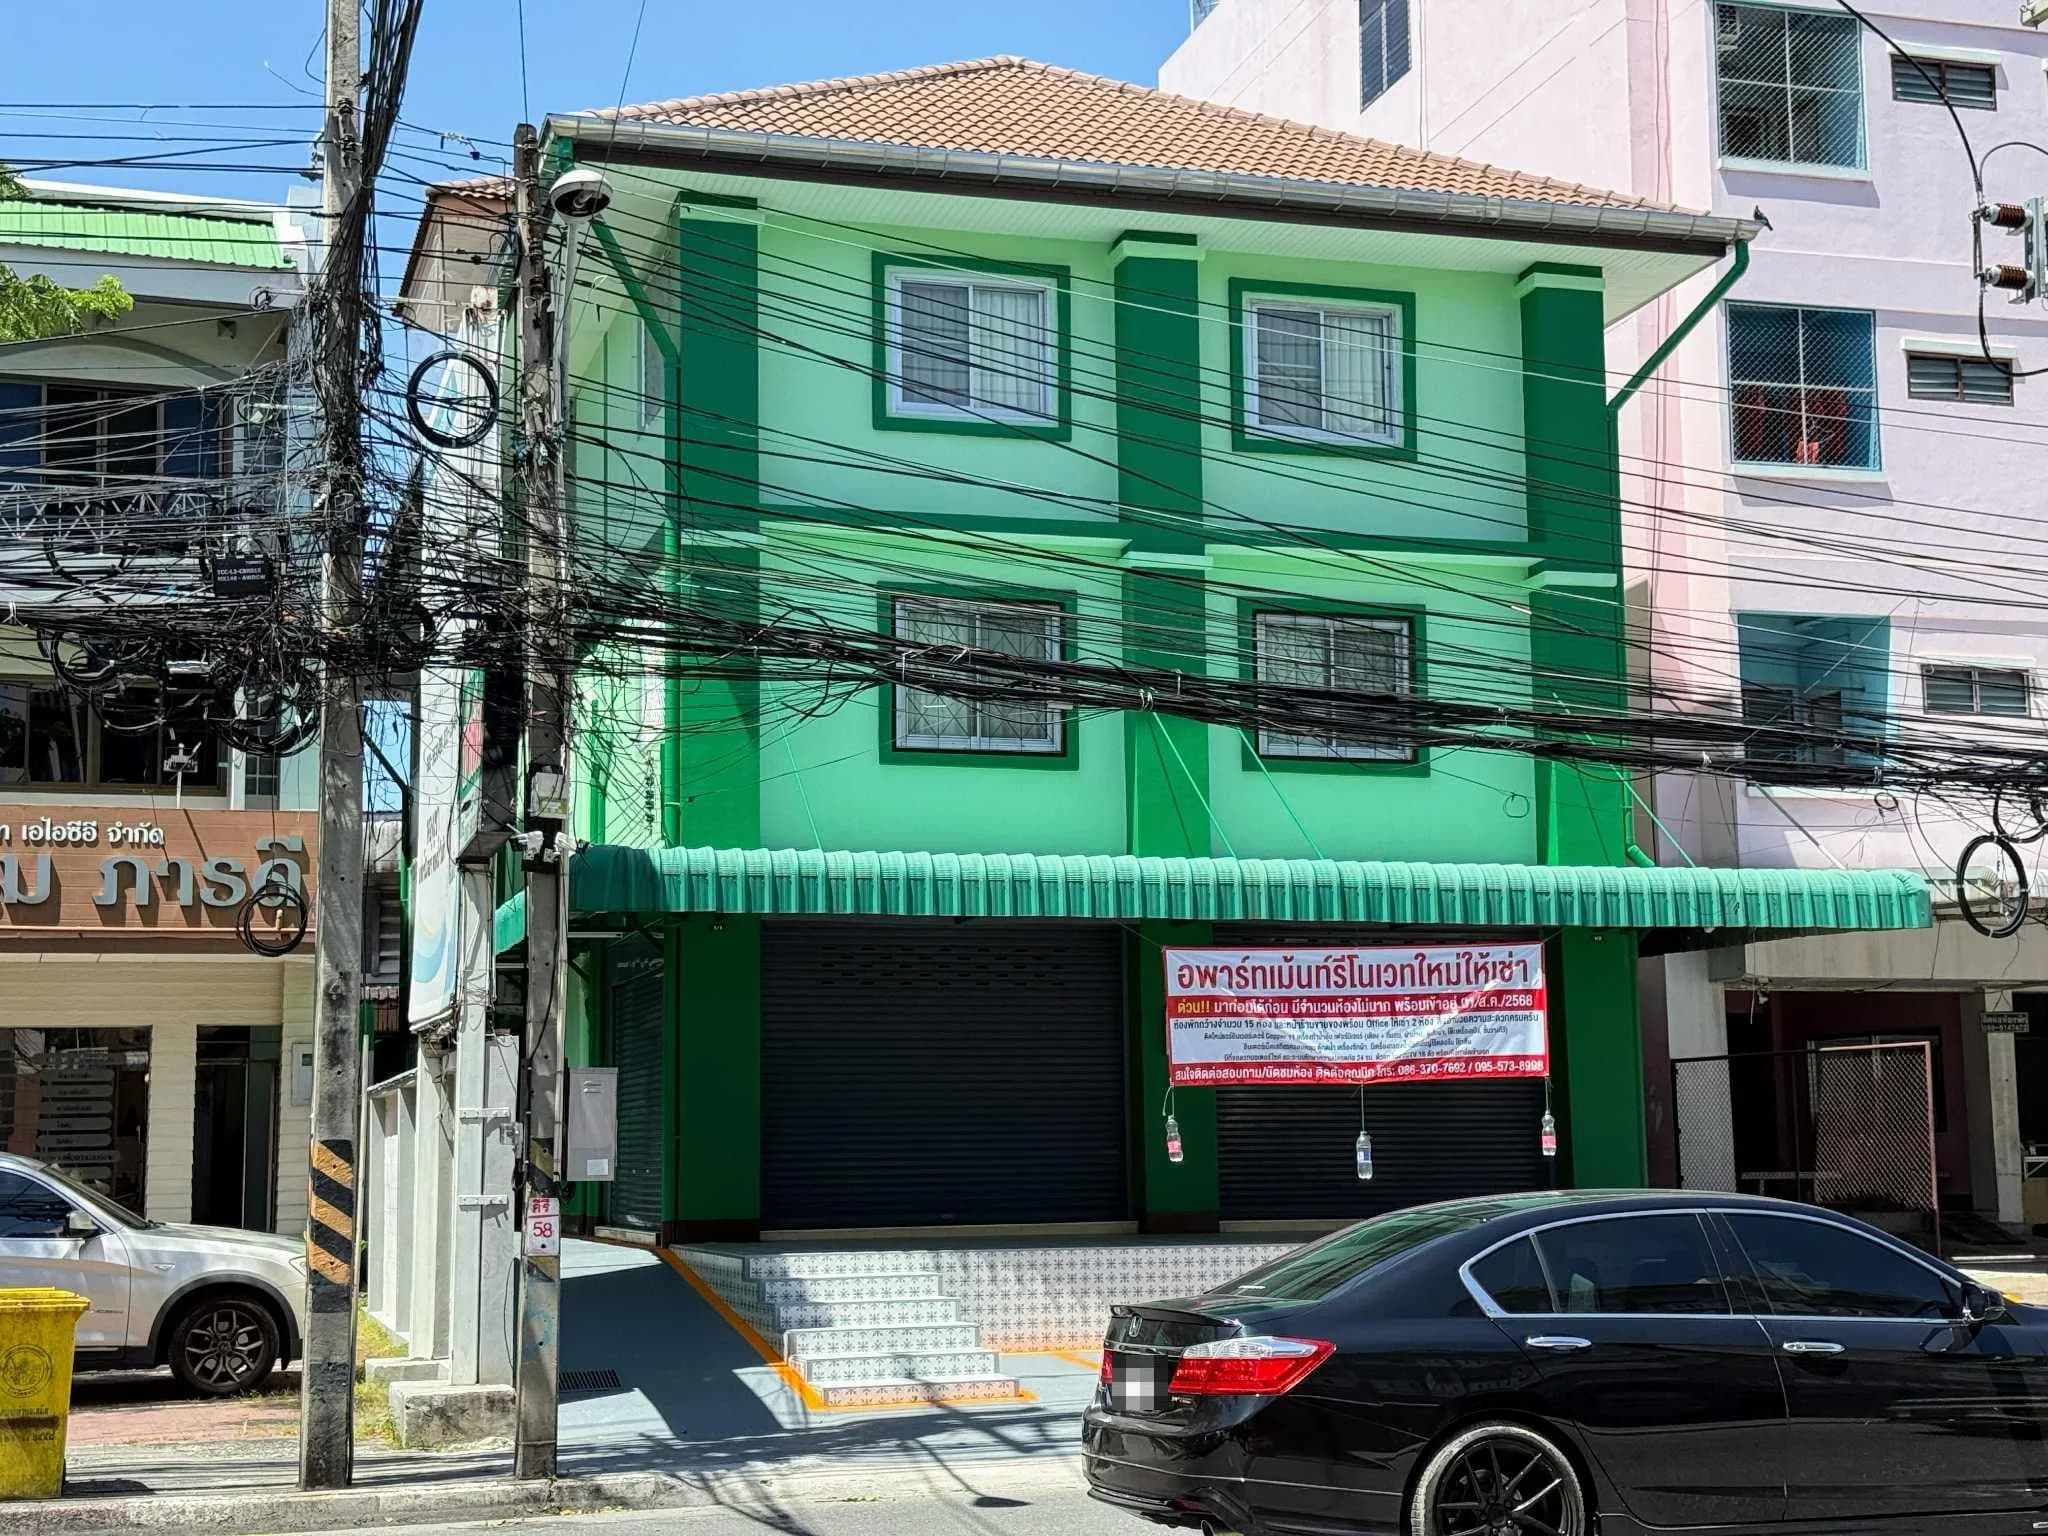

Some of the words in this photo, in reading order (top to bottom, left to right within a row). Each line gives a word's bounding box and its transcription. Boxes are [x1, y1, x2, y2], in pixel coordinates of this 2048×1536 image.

[22, 816, 98, 841] เอไอซีอี
[107, 821, 165, 846] จำกัด
[1177, 951, 1529, 990] อพาร์ทเม้นท์รีโนเวทใหม่ให้เช่า
[1177, 998, 1210, 1013] ด่วน!!
[1292, 997, 1391, 1014] มีจำนวนห้องไม่มาก
[1244, 1019, 1254, 1028] 15
[533, 1222, 552, 1238] 58
